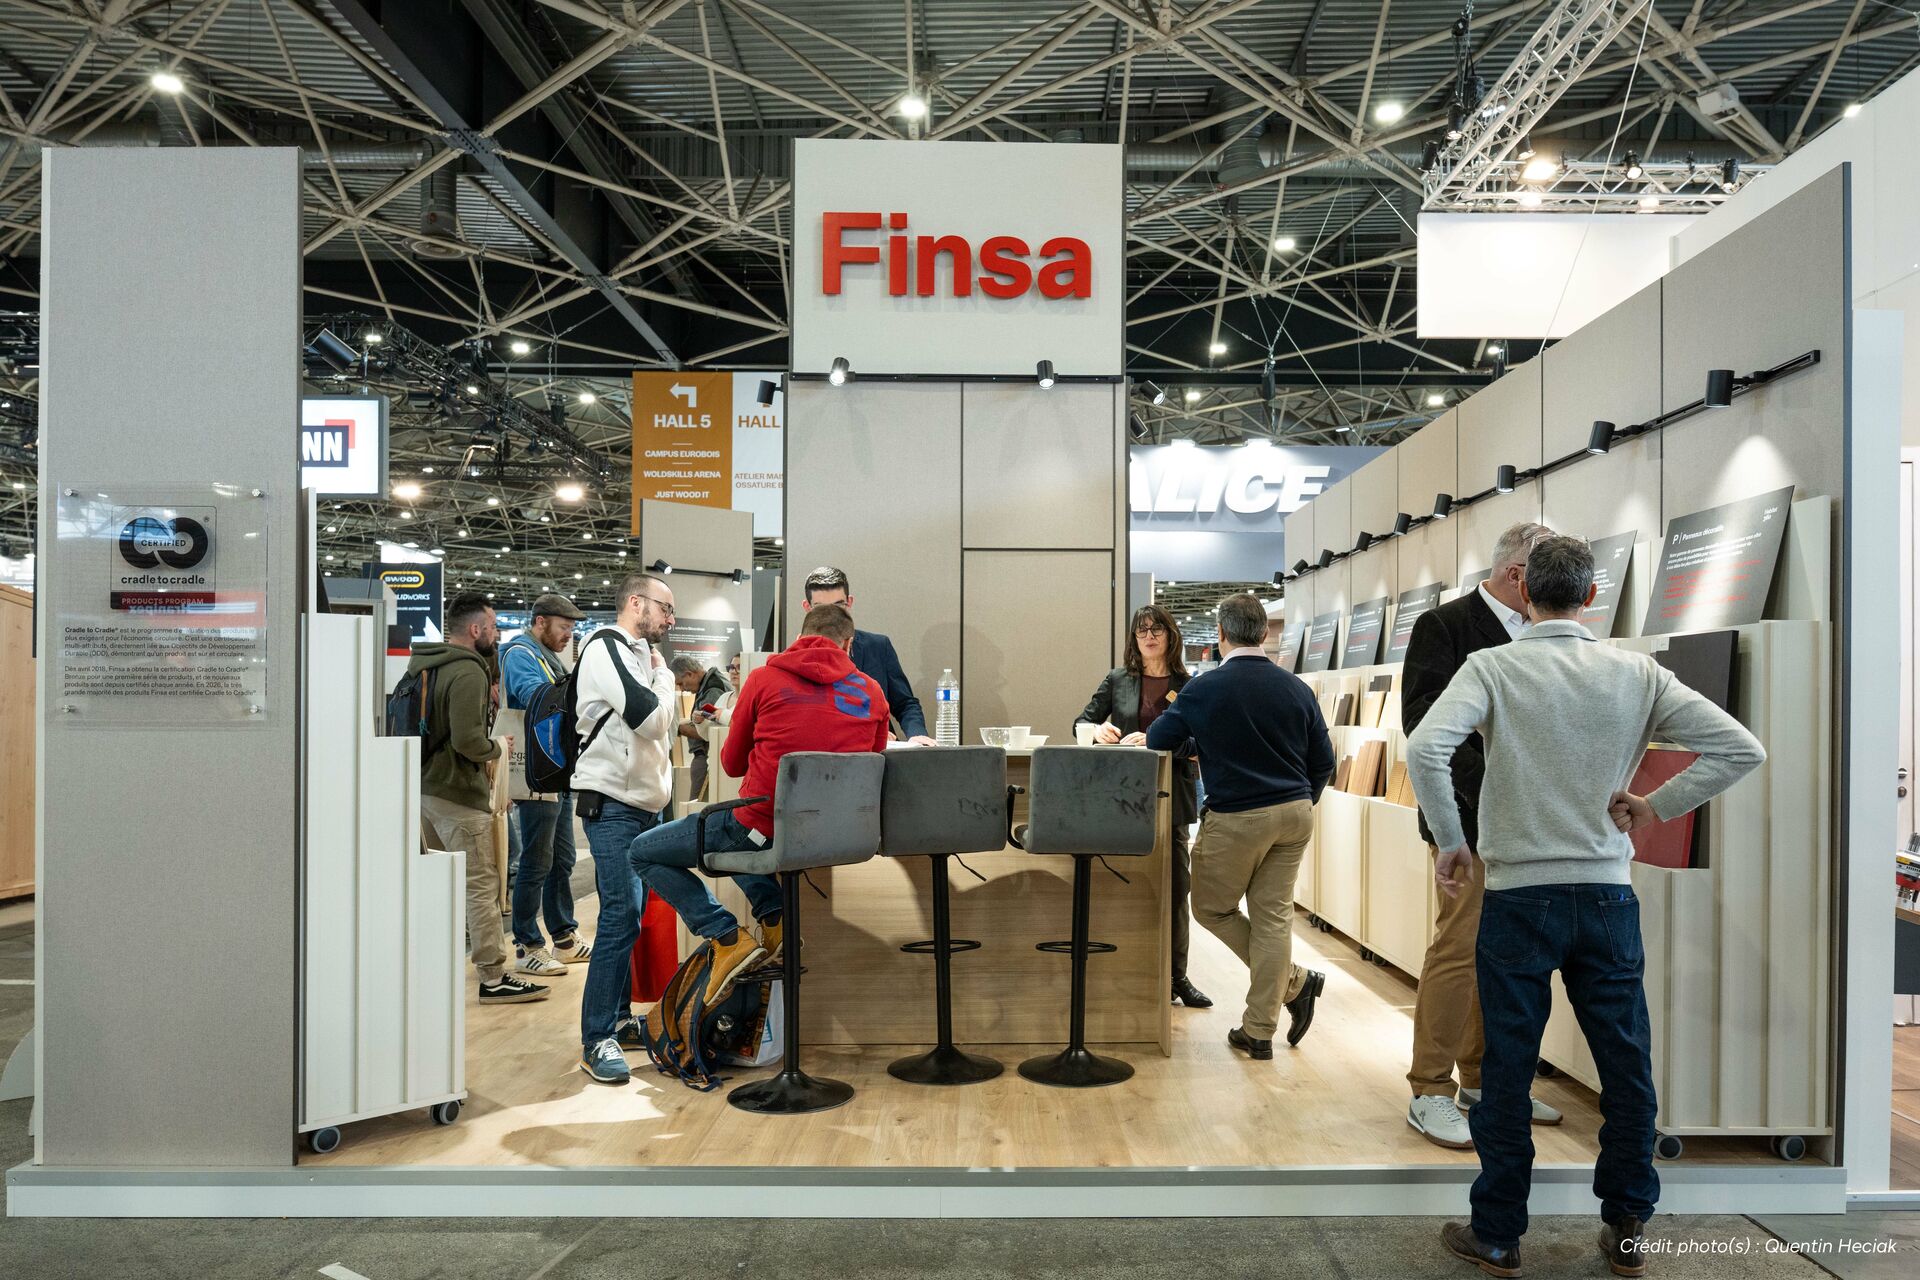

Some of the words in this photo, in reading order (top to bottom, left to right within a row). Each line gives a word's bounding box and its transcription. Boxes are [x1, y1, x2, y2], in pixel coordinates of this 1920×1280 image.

[823, 212, 1092, 299] Finsa
[654, 415, 697, 428] HALL
[700, 414, 712, 428] 5
[738, 415, 781, 428] HALL
[645, 450, 679, 458] CAMPUS
[680, 450, 720, 458] EUROBOIS
[643, 470, 693, 479] WOLDSKILLS
[694, 471, 721, 479] ARENA
[655, 491, 674, 499] JUST
[675, 490, 700, 499] WOOD
[701, 491, 709, 499] IT
[141, 539, 186, 547] CERTIFIED
[121, 575, 156, 584] cradle
[158, 575, 169, 584] to
[170, 575, 205, 584] cradle
[137, 627, 173, 635] programme
[65, 634, 78, 642] plus
[164, 650, 187, 658] produit
[64, 689, 86, 697] grande
[125, 689, 150, 697] produits
